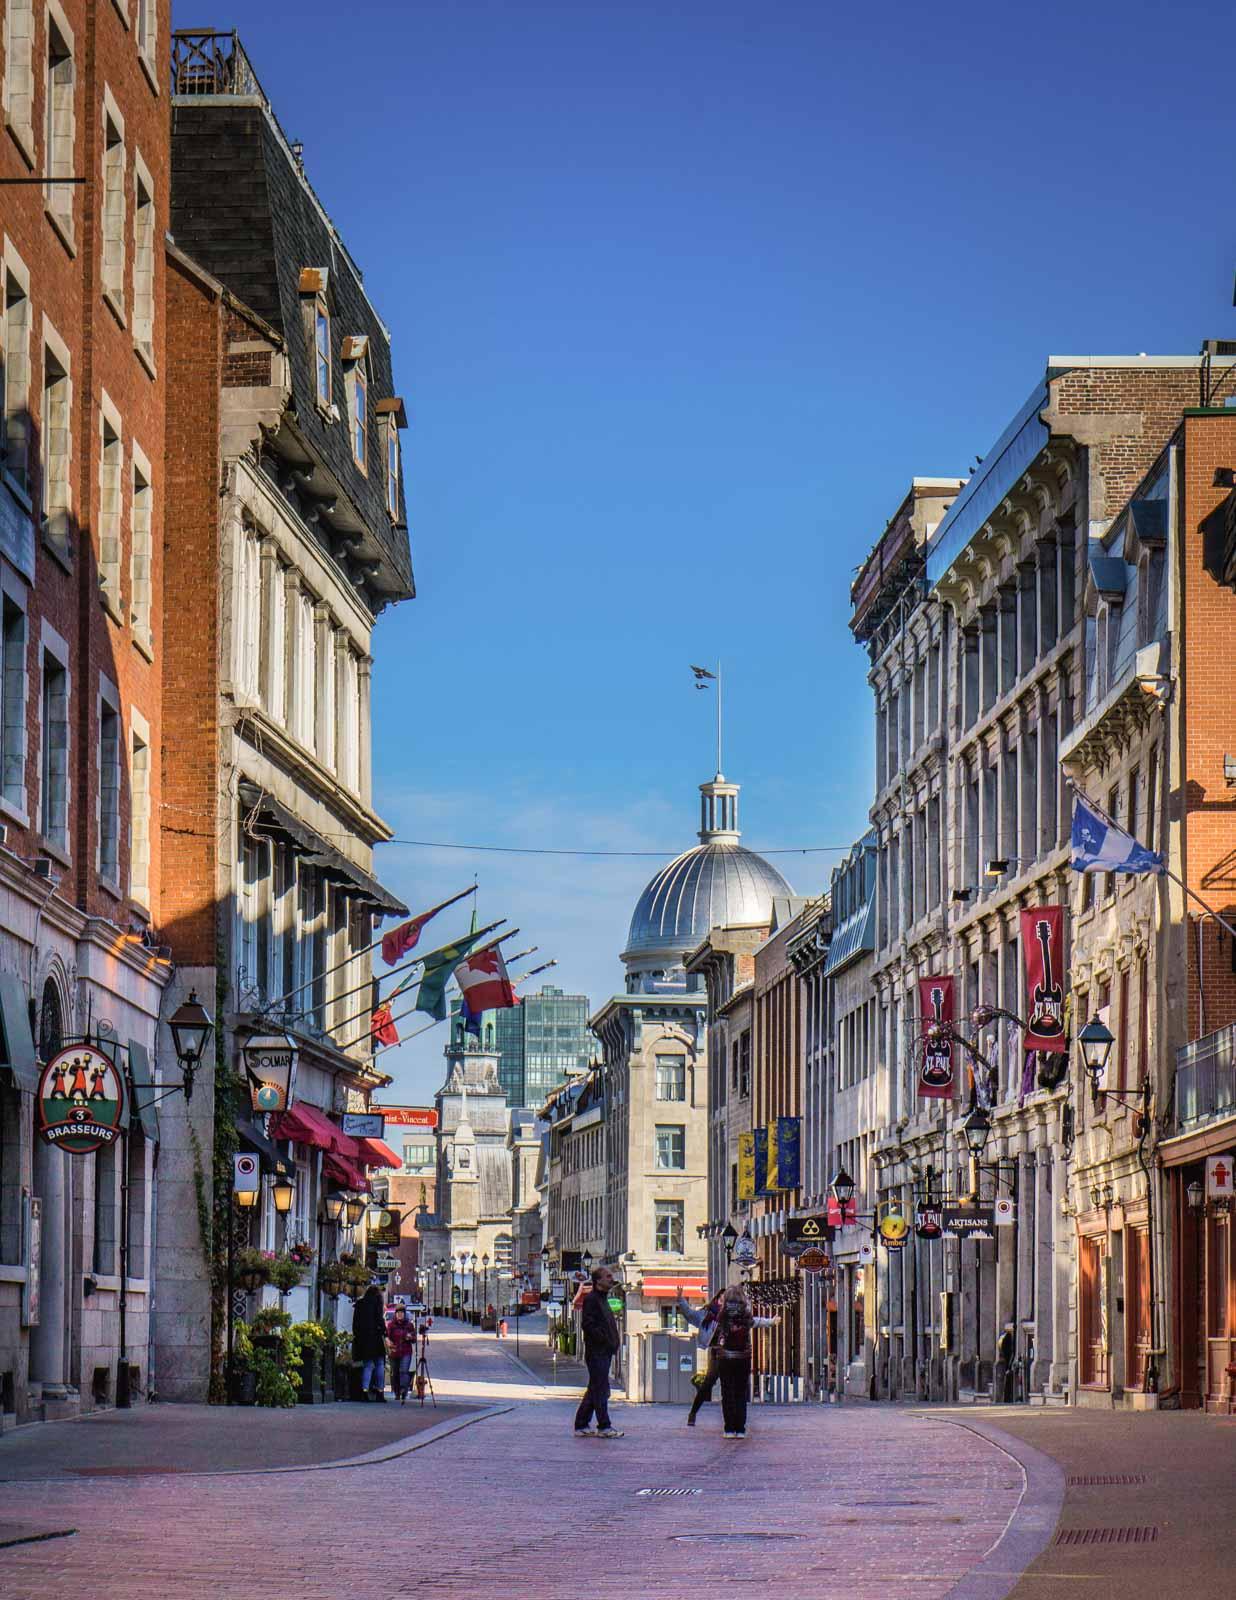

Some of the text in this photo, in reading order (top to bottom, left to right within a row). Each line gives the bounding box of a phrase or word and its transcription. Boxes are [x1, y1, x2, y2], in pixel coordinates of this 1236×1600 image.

[1045, 1002, 1062, 1026] PAUL
[76, 1110, 84, 1121] 3
[384, 1114, 428, 1124] aint-Vincent
[47, 1124, 113, 1140] BRASSEURS
[948, 1219, 988, 1228] ARTISANS
[883, 1239, 906, 1247] Amber
